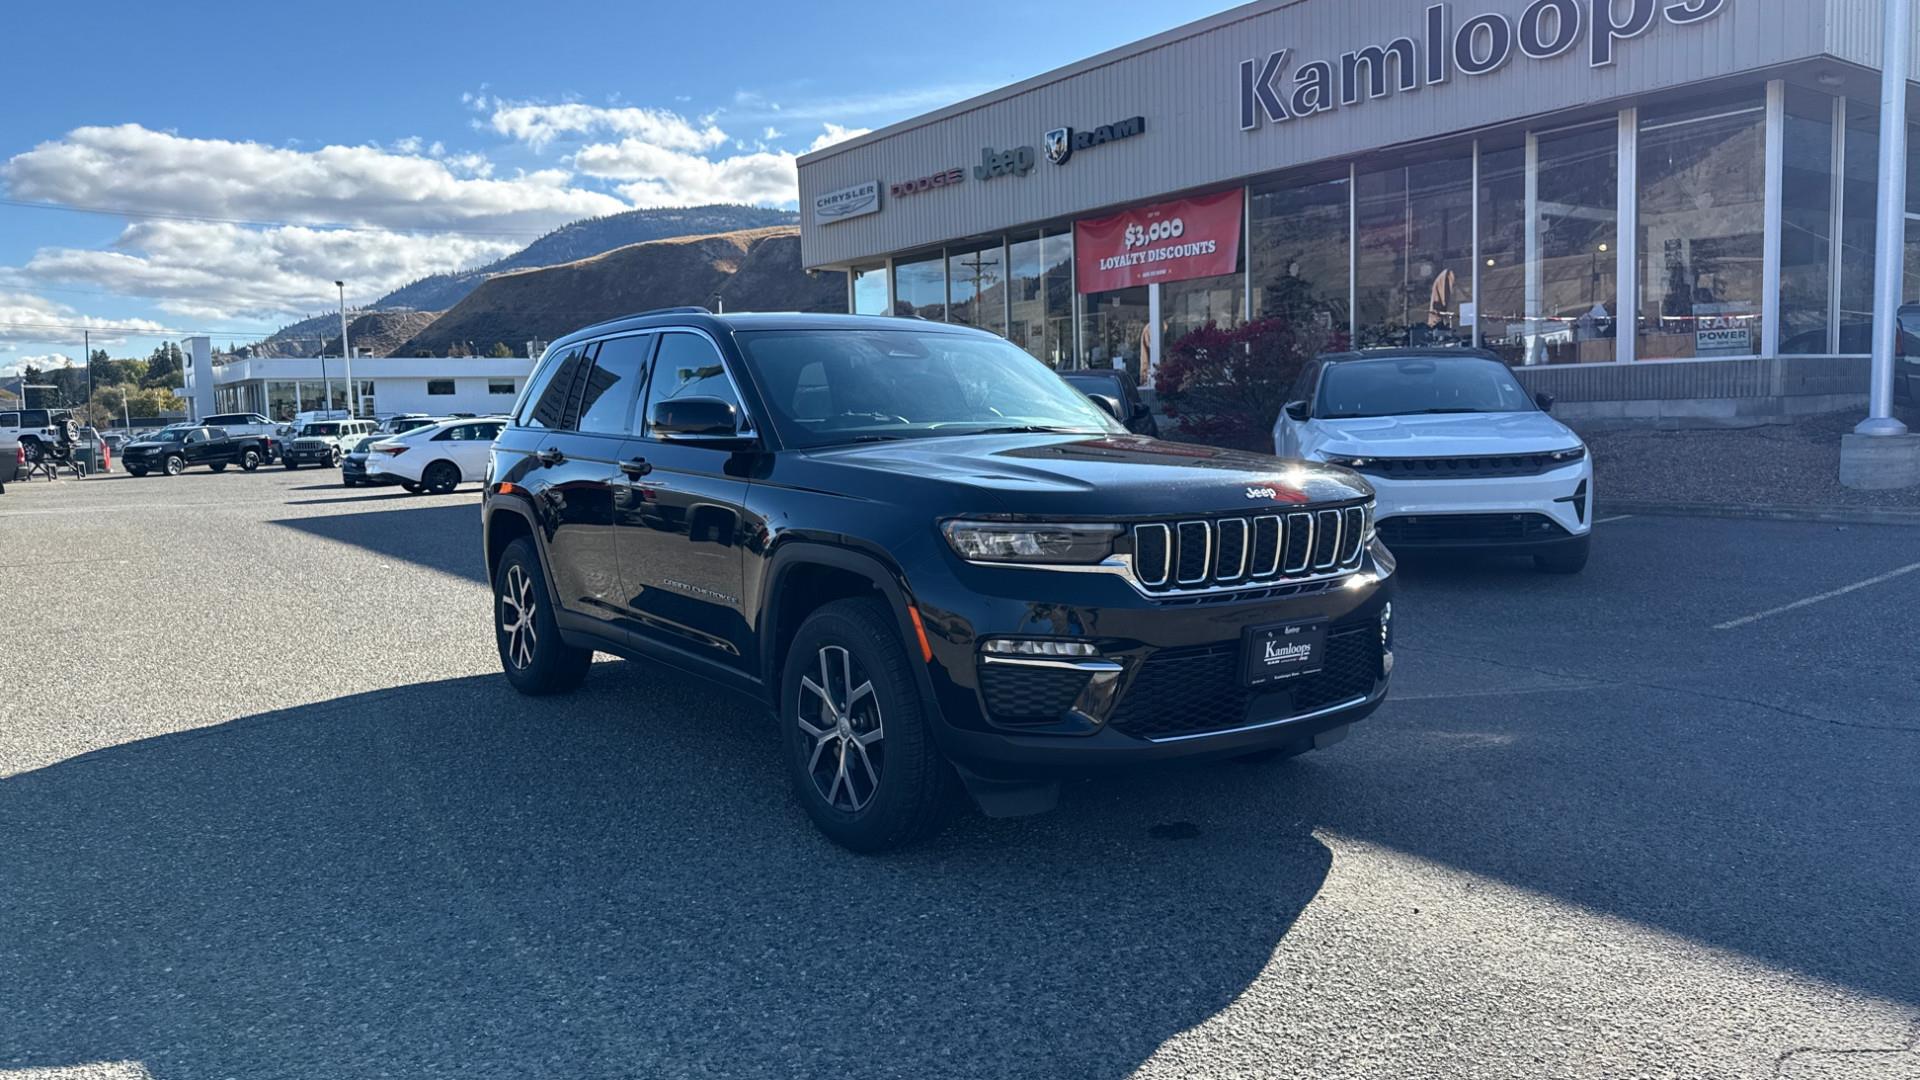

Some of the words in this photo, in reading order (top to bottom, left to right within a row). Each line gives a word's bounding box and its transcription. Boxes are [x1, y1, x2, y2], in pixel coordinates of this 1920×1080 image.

[1072, 116, 1145, 151] RAM
[973, 146, 1035, 181] Jeep
[816, 185, 875, 208] CHRYSLER
[890, 168, 965, 199] DODGE
[1125, 217, 1184, 250] $3,000
[1100, 251, 1146, 271] LOYALTY
[1148, 240, 1216, 262] DISCOUNTS
[1699, 330, 1747, 341] POWER
[1246, 487, 1277, 499] Jeep
[1264, 640, 1311, 658] Kamloops
